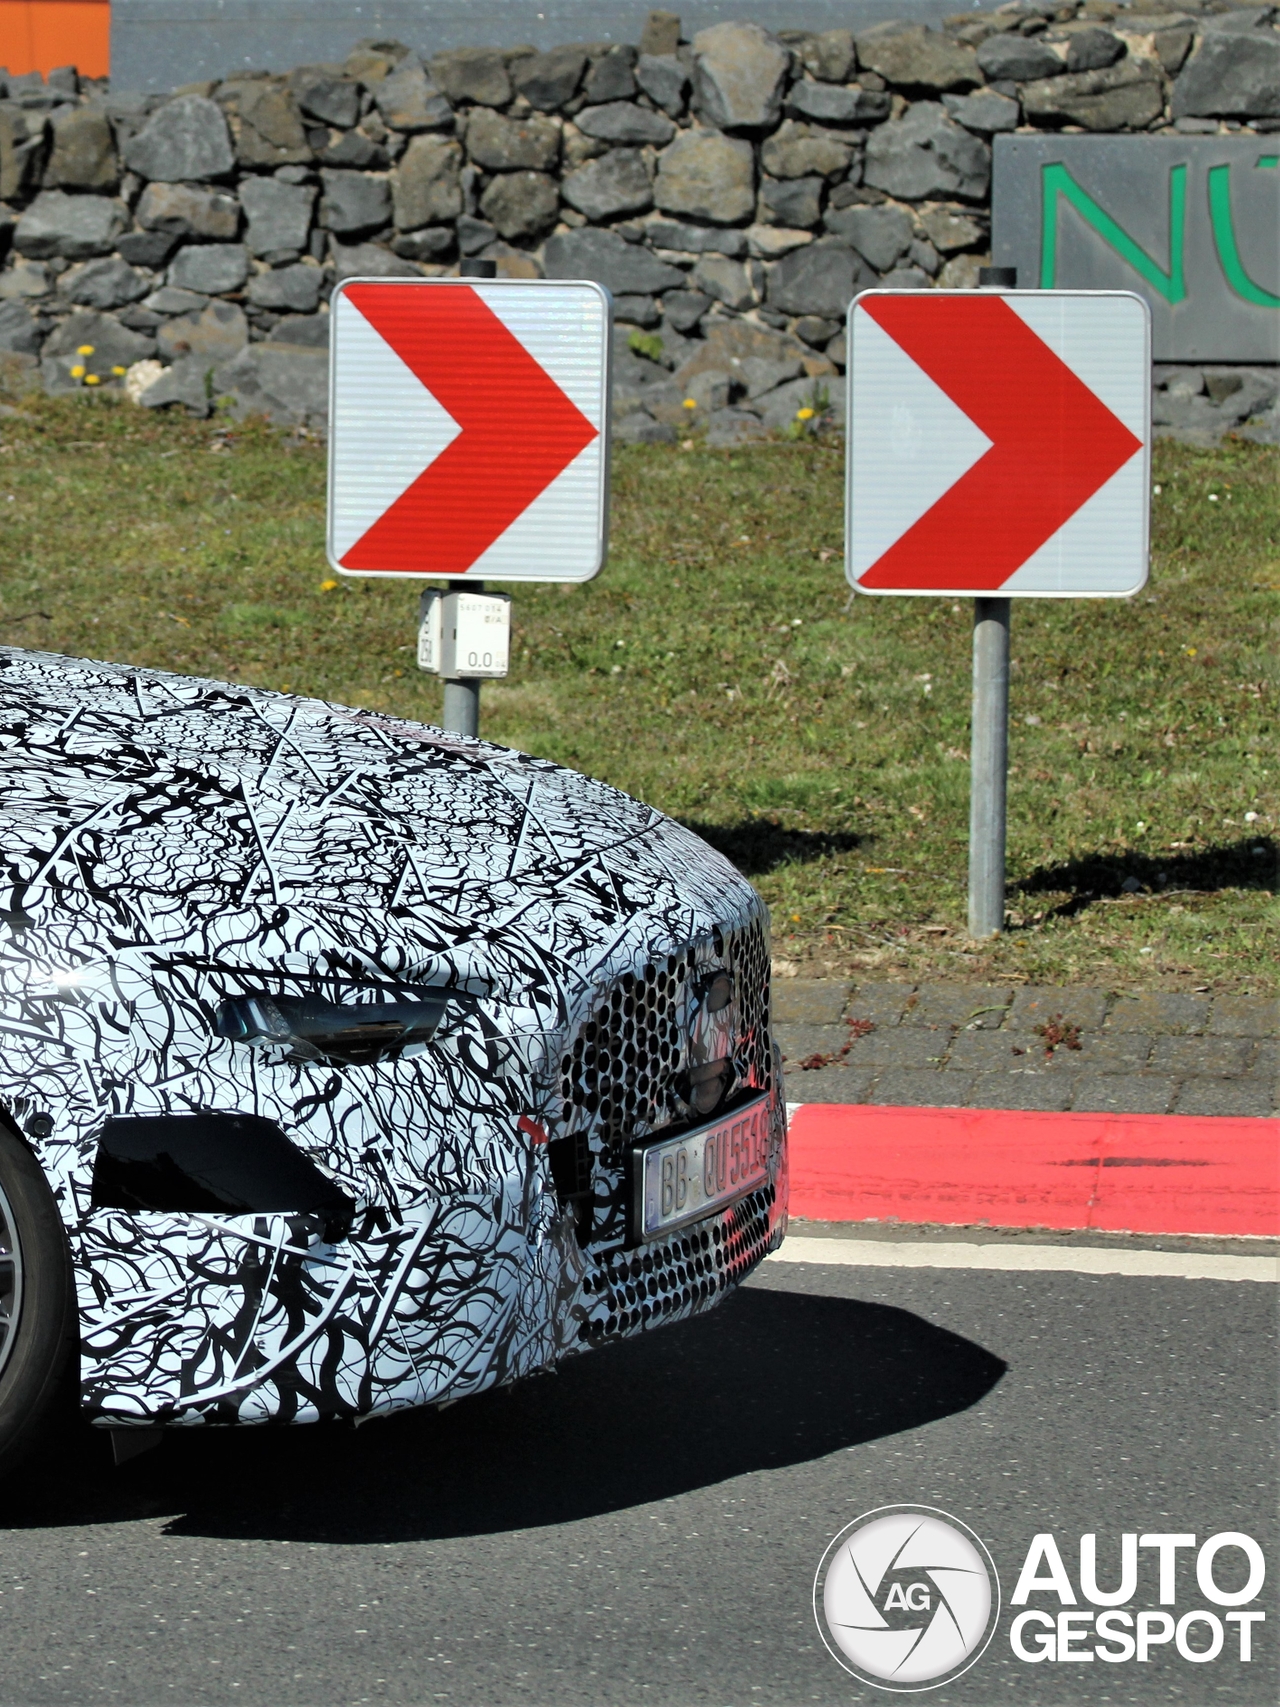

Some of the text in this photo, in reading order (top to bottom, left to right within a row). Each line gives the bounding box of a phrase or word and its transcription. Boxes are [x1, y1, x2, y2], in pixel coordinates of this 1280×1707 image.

[662, 1108, 770, 1217] BB QU 5518
